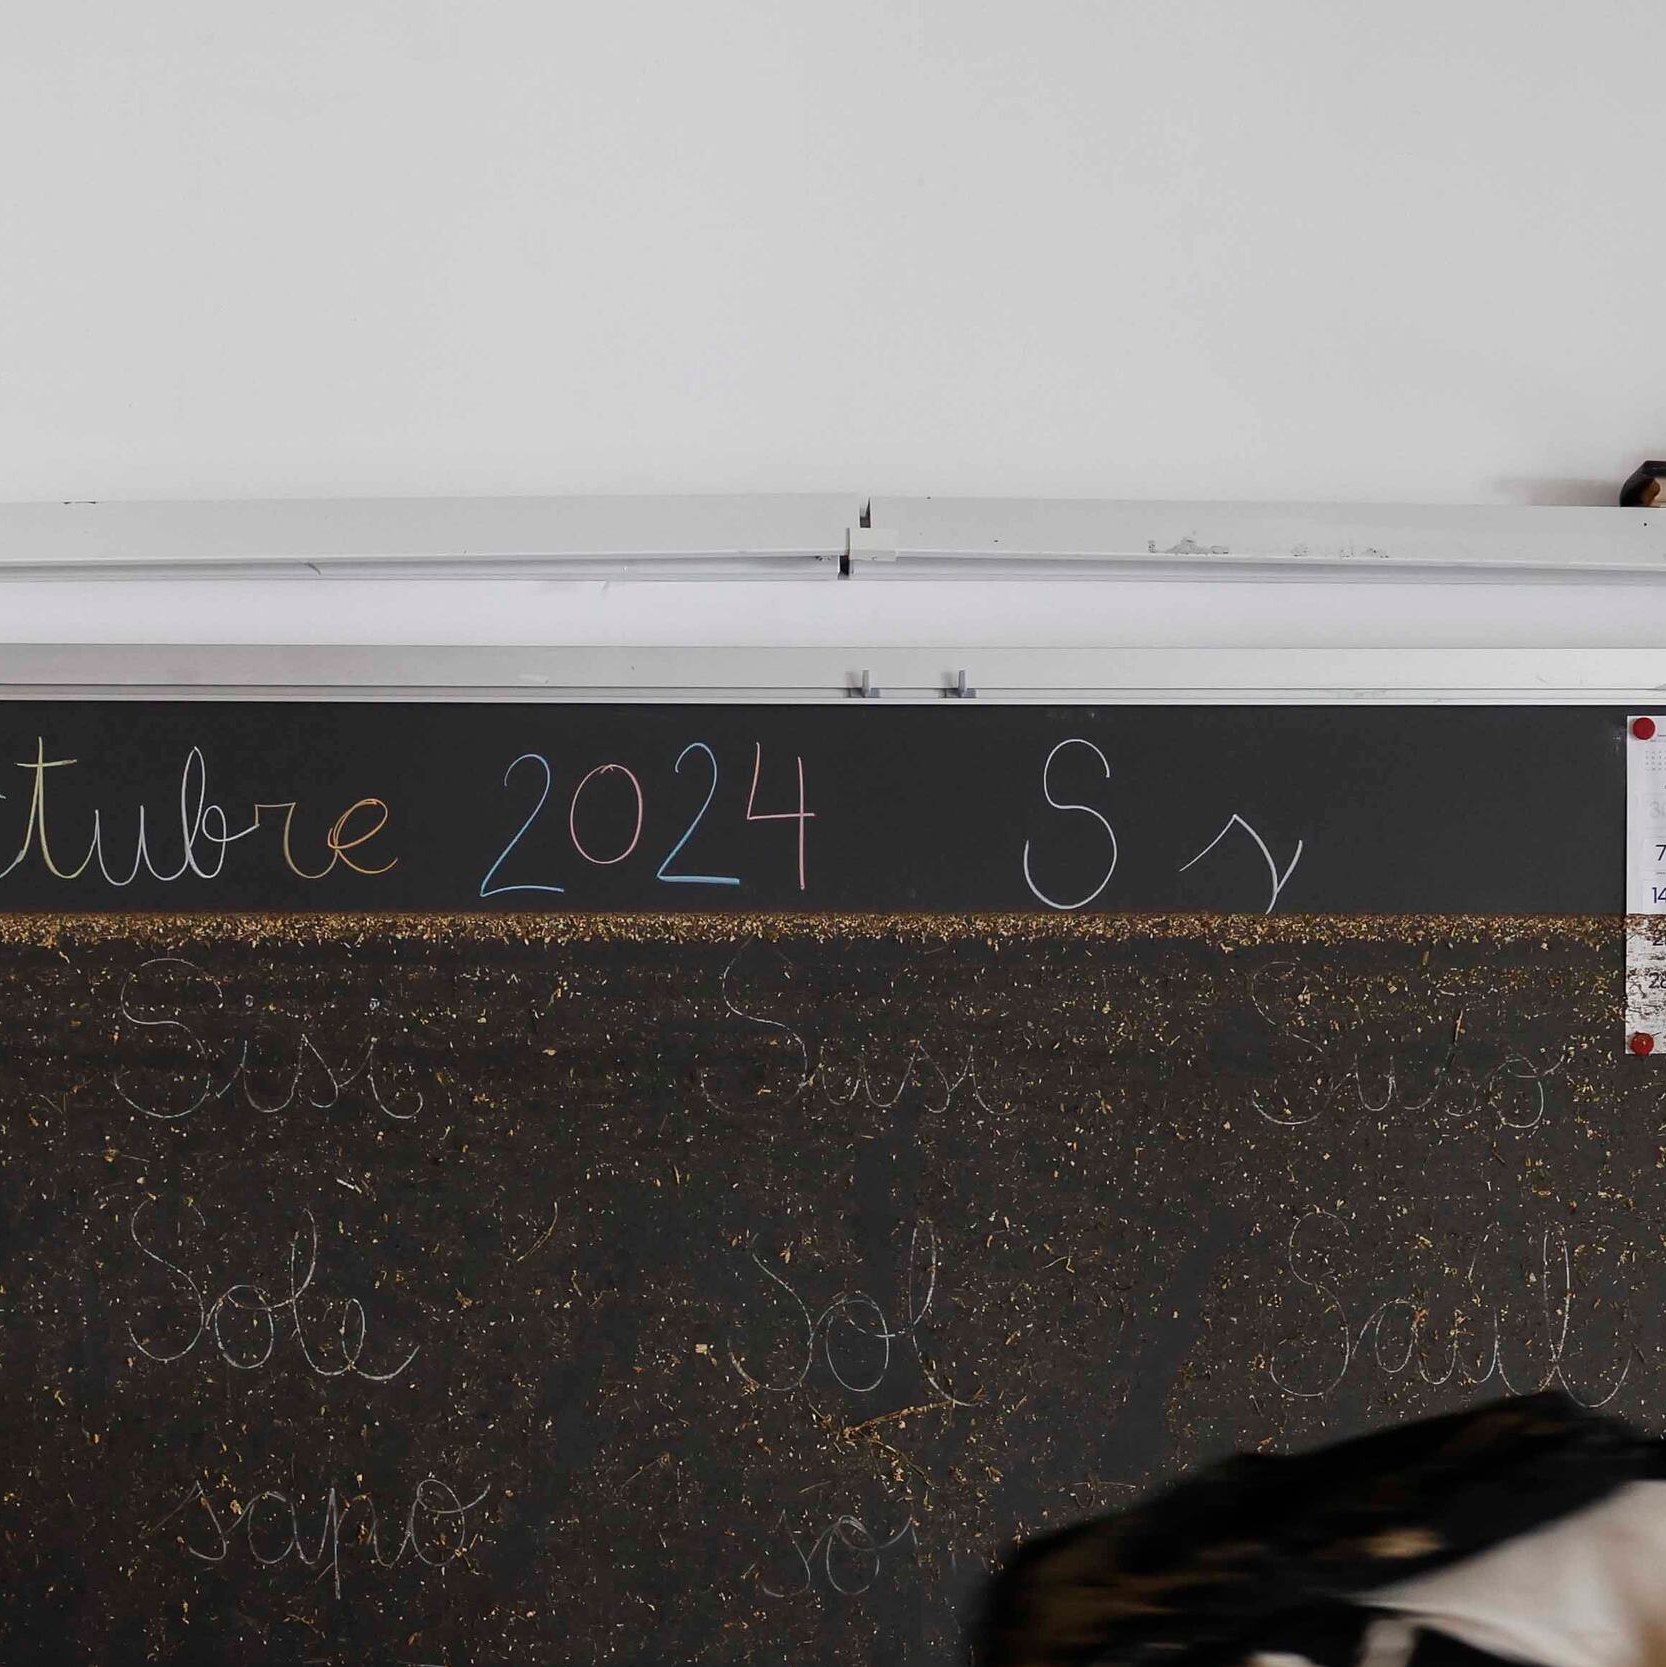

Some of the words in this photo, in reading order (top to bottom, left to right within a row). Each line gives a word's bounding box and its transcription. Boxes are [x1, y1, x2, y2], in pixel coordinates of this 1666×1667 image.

[480, 742, 815, 897] 2024
[1655, 844, 1666, 862] 7
[128, 1197, 421, 1381] Sole
[139, 1476, 493, 1601] sapo
